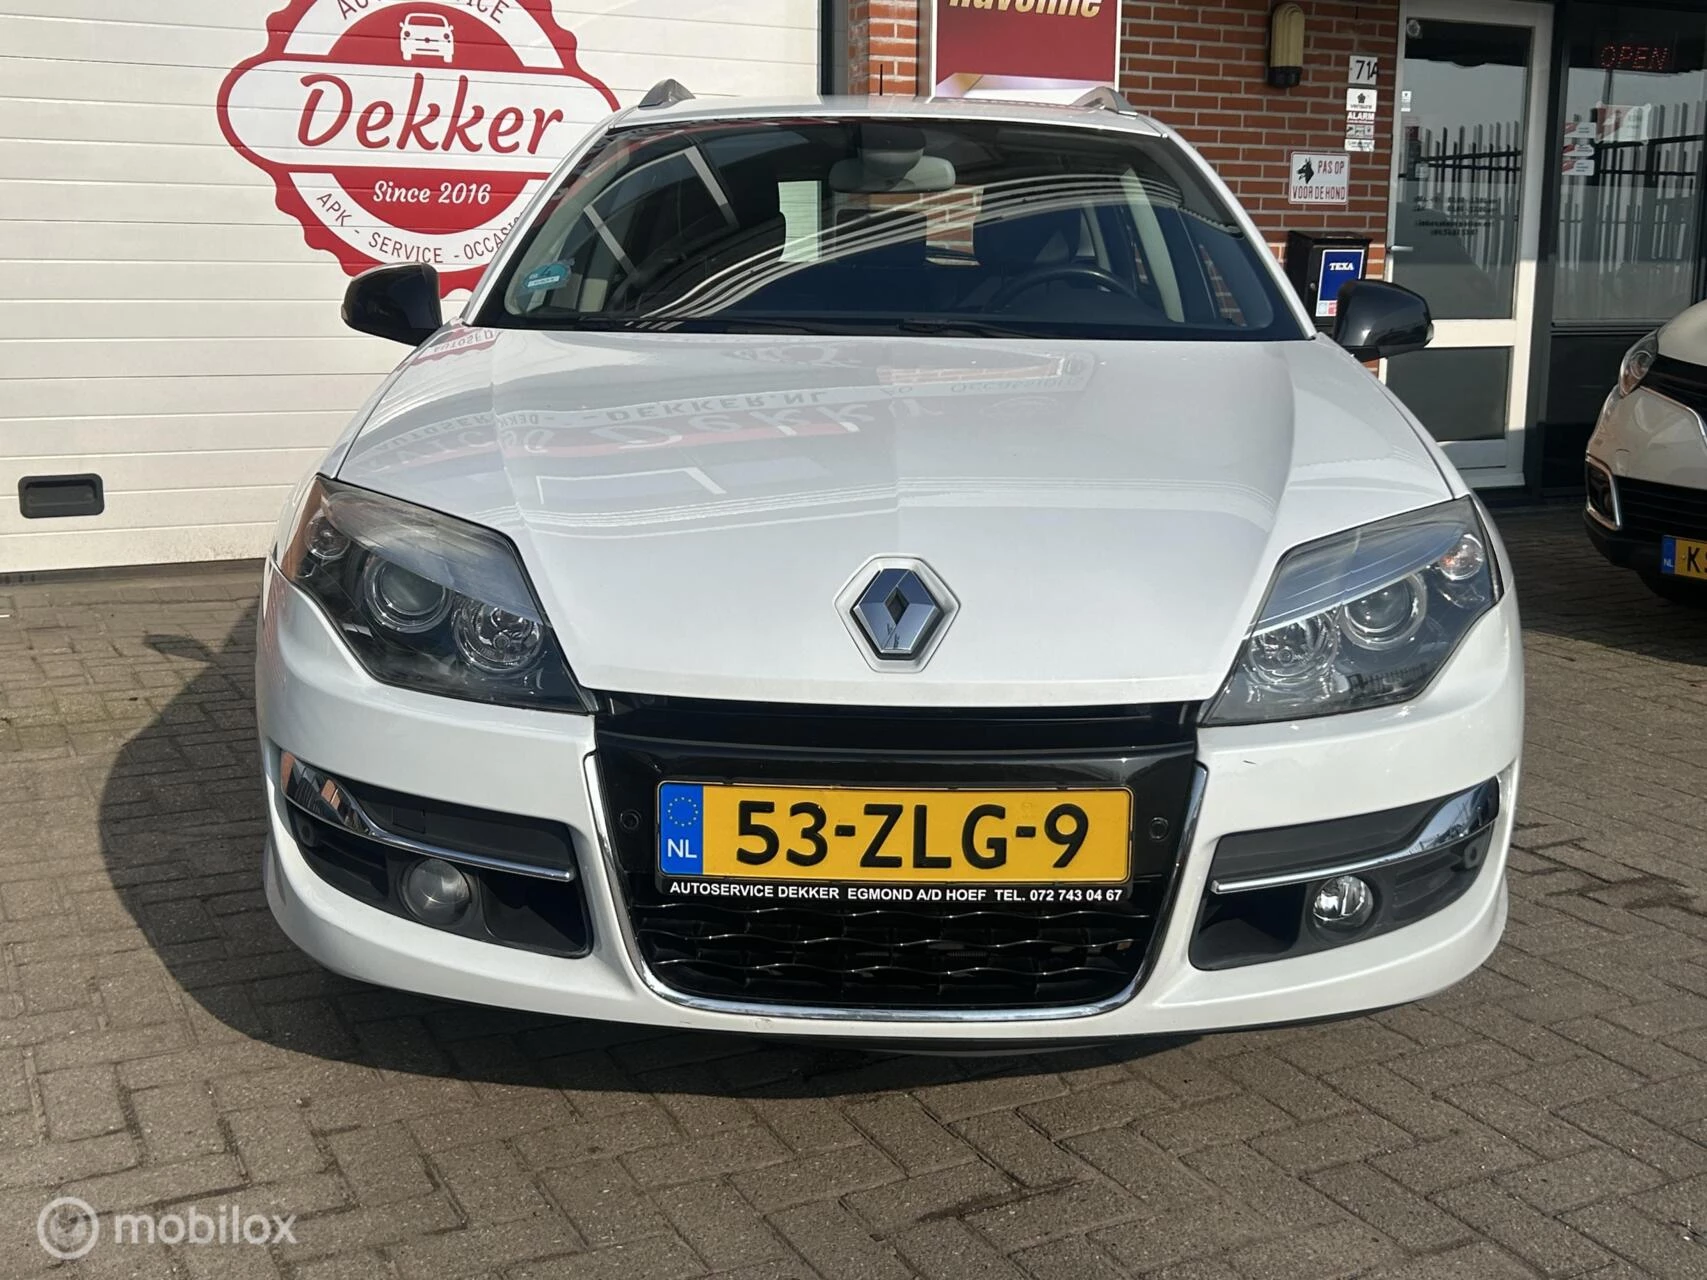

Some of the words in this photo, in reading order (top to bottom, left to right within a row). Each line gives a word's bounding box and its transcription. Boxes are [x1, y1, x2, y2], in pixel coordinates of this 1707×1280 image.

[1601, 45, 1668, 70] OPEN
[297, 72, 564, 155] Dekker
[1347, 111, 1375, 120] ALARM
[1317, 160, 1333, 174] PAS
[1334, 160, 1345, 174] OP
[373, 180, 431, 203] Since
[438, 182, 492, 205] 2016
[1293, 185, 1313, 199] VOOR
[1315, 186, 1325, 200] DE
[1325, 187, 1346, 200] HOND
[316, 192, 352, 227] APK
[368, 231, 443, 264] SERVICE
[1328, 262, 1354, 271] TEXA
[1686, 546, 1707, 574] K
[736, 800, 1089, 871] 53-ZLG-9
[667, 838, 697, 859] NL
[670, 881, 774, 897] AUTOSERVICE
[778, 885, 840, 899] DEKKER
[847, 887, 913, 900] EGMOND
[917, 888, 942, 901] A/D
[946, 889, 986, 901] HOEF
[994, 889, 1026, 901] TEL.
[1030, 889, 1054, 901] 072
[1058, 890, 1082, 901] 743
[1086, 889, 1102, 901] 04
[1106, 889, 1123, 901] 67
